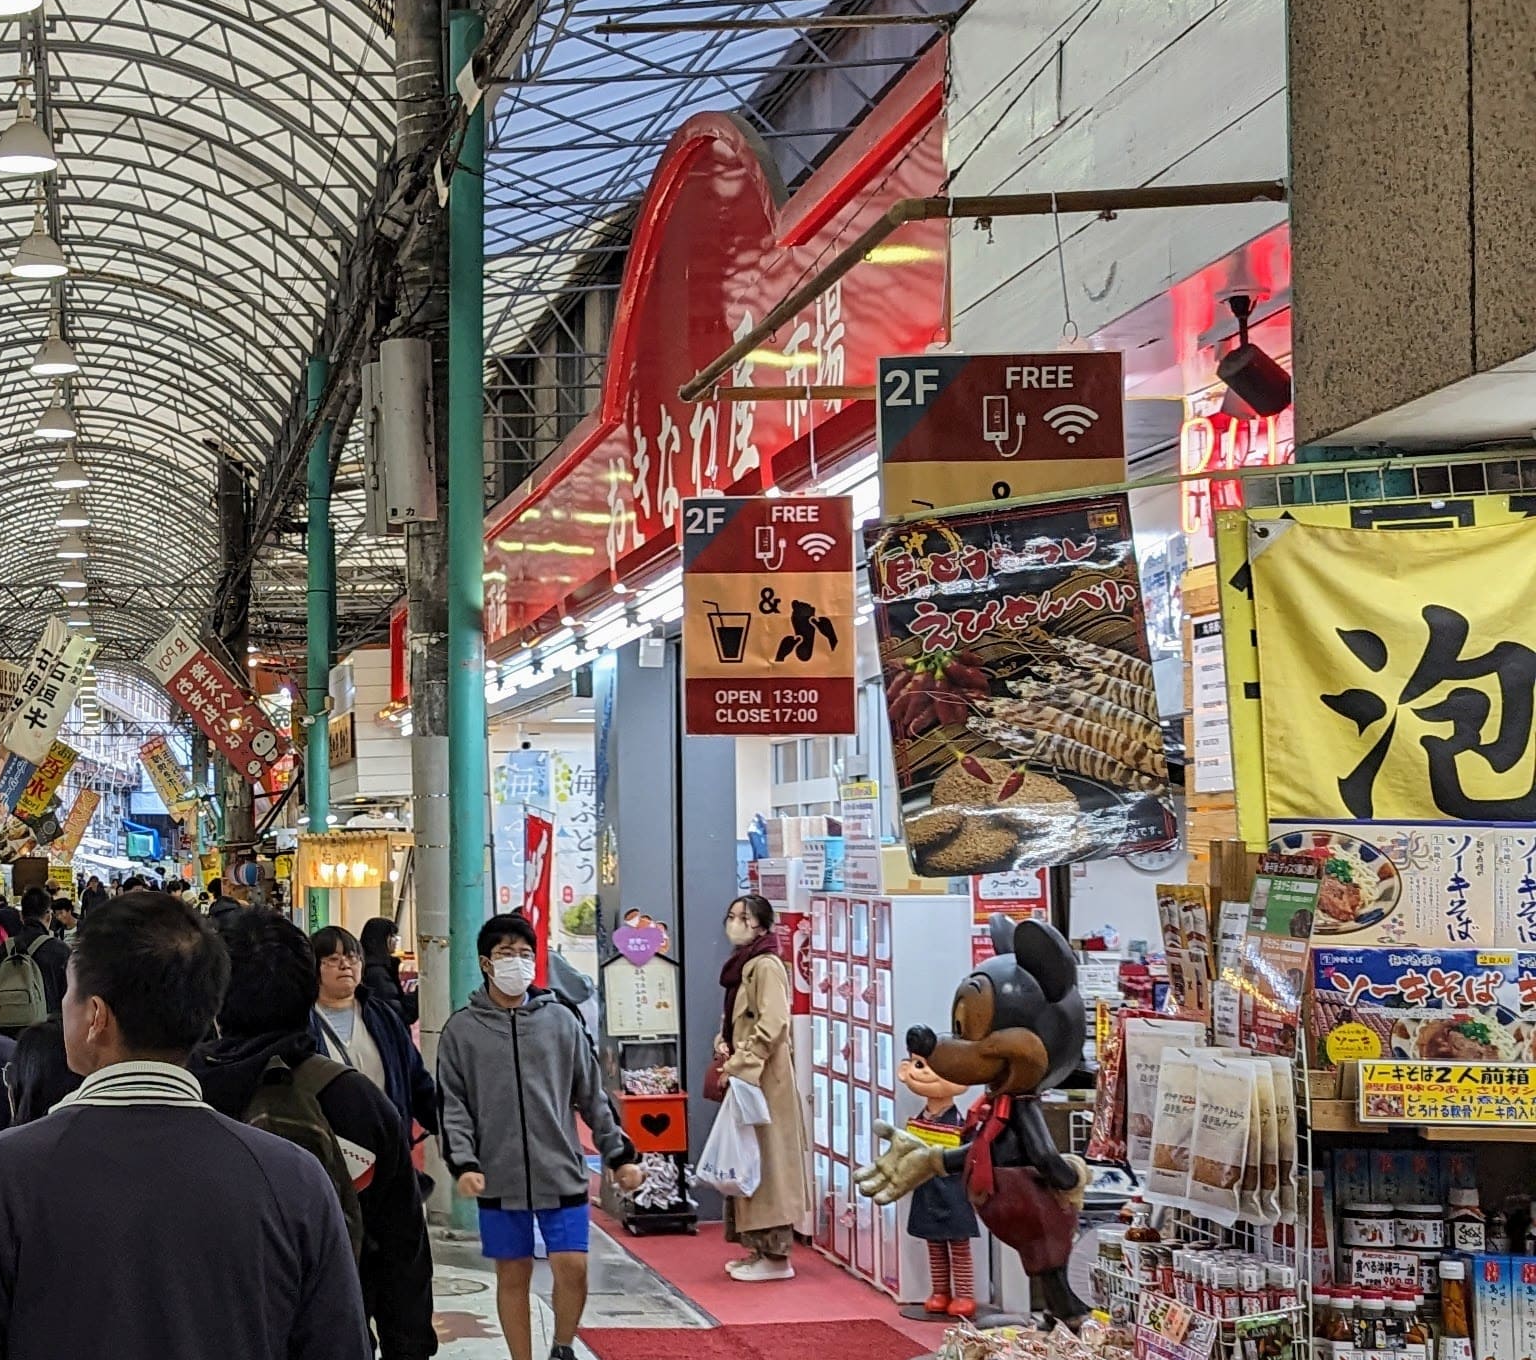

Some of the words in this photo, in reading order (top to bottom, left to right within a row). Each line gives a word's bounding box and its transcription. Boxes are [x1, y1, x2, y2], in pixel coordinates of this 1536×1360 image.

[884, 370, 939, 406] 2F
[1006, 366, 1074, 389] FREE
[685, 508, 725, 534] 2F
[772, 506, 819, 522] FREE
[911, 580, 1137, 652] えびせんべい
[24, 660, 71, 729] 石垣牛
[715, 690, 761, 704] OPEN
[773, 689, 819, 704] 13:00
[715, 709, 770, 723] CLOSE
[772, 709, 817, 723] 17:00
[991, 878, 1029, 889] クーポン
[1446, 835, 1480, 944] ソーキそば
[1331, 969, 1503, 1006] ソーキそば
